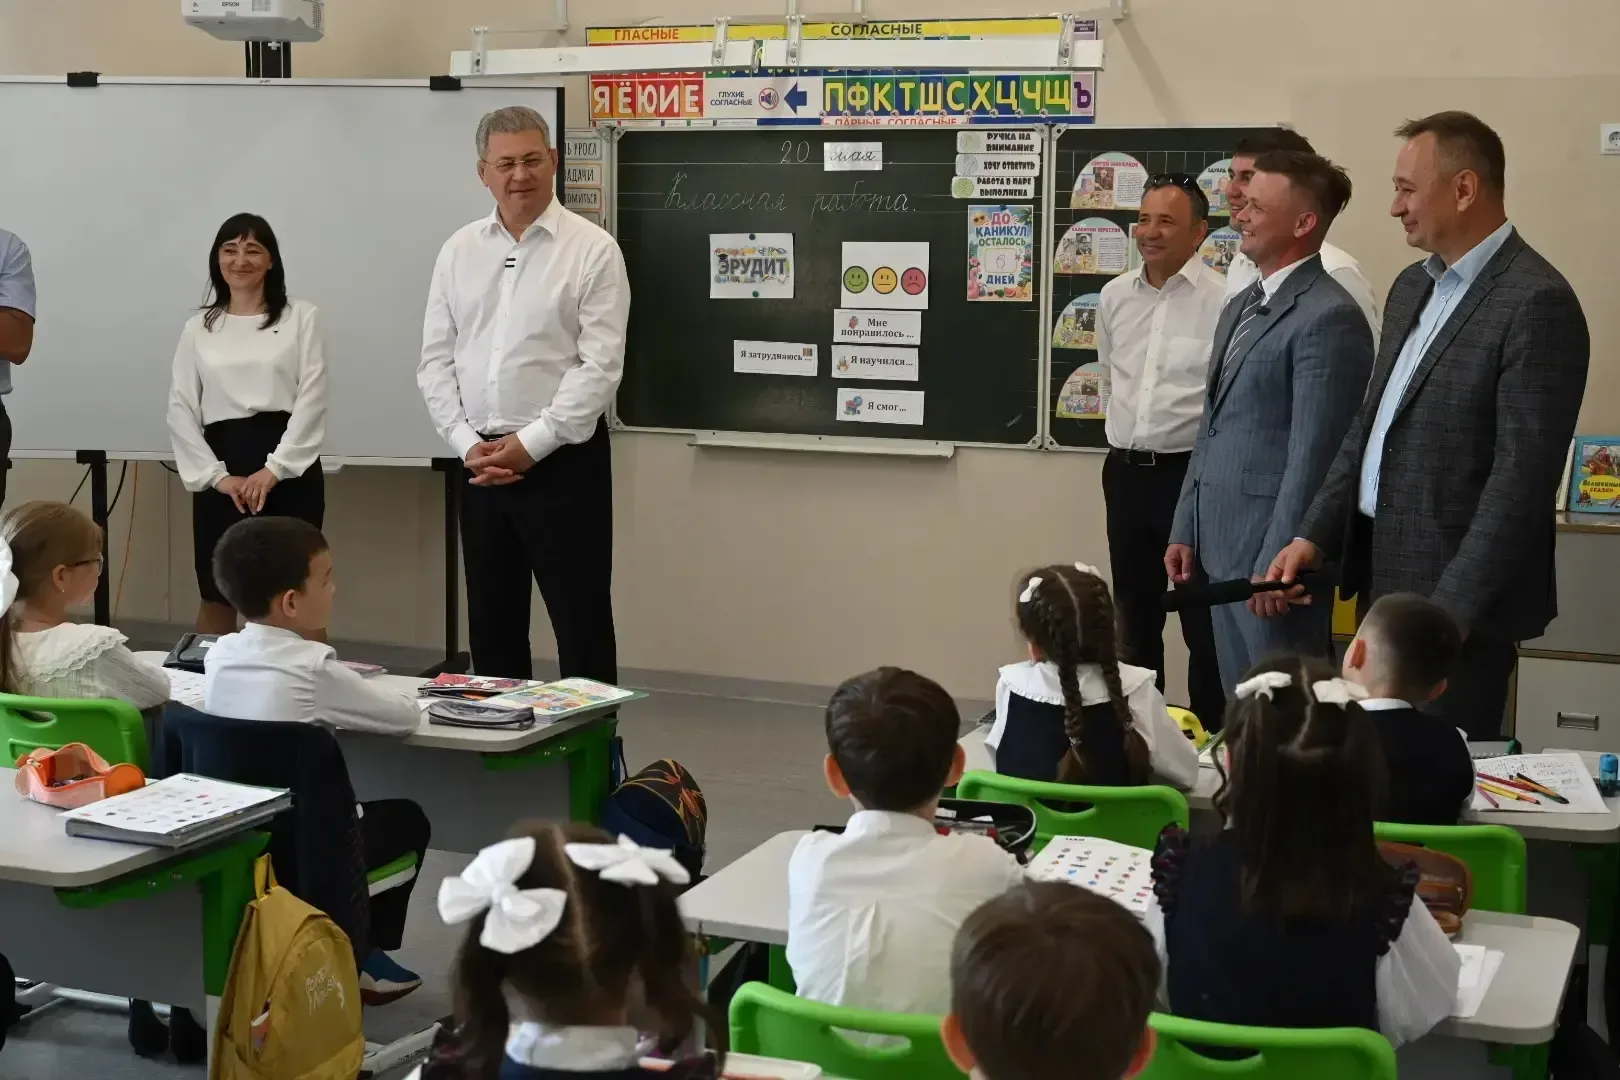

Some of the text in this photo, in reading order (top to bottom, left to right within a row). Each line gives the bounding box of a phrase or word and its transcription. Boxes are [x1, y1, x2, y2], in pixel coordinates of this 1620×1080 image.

[614, 28, 679, 41] ГЛАСНЫЕ
[831, 23, 922, 36] СОГЛАСНЫЕ
[574, 142, 597, 156] УРОКА
[780, 140, 876, 164] 20 мая
[985, 144, 1034, 152] ВНИМАНИЕ
[983, 161, 1035, 170] ХОЧУ ОТВЕТИТЬ
[564, 168, 594, 183] АДАЧИ
[664, 171, 916, 223] Классная работа.
[980, 188, 1028, 197] ВЫПОЛНЕНА
[991, 212, 1011, 225] ДО
[975, 226, 1027, 237] КАНИКУЛ
[978, 237, 1026, 247] ОСТАЛОСЬ
[718, 257, 787, 277] ЭРУДИТ
[985, 273, 1015, 285] ДНЕЙ
[867, 317, 888, 327] Мне
[840, 328, 904, 339] понравилось
[740, 350, 746, 358] Я
[748, 352, 803, 362] затрудняюсь
[850, 355, 857, 364] Я
[867, 402, 874, 410] Я
